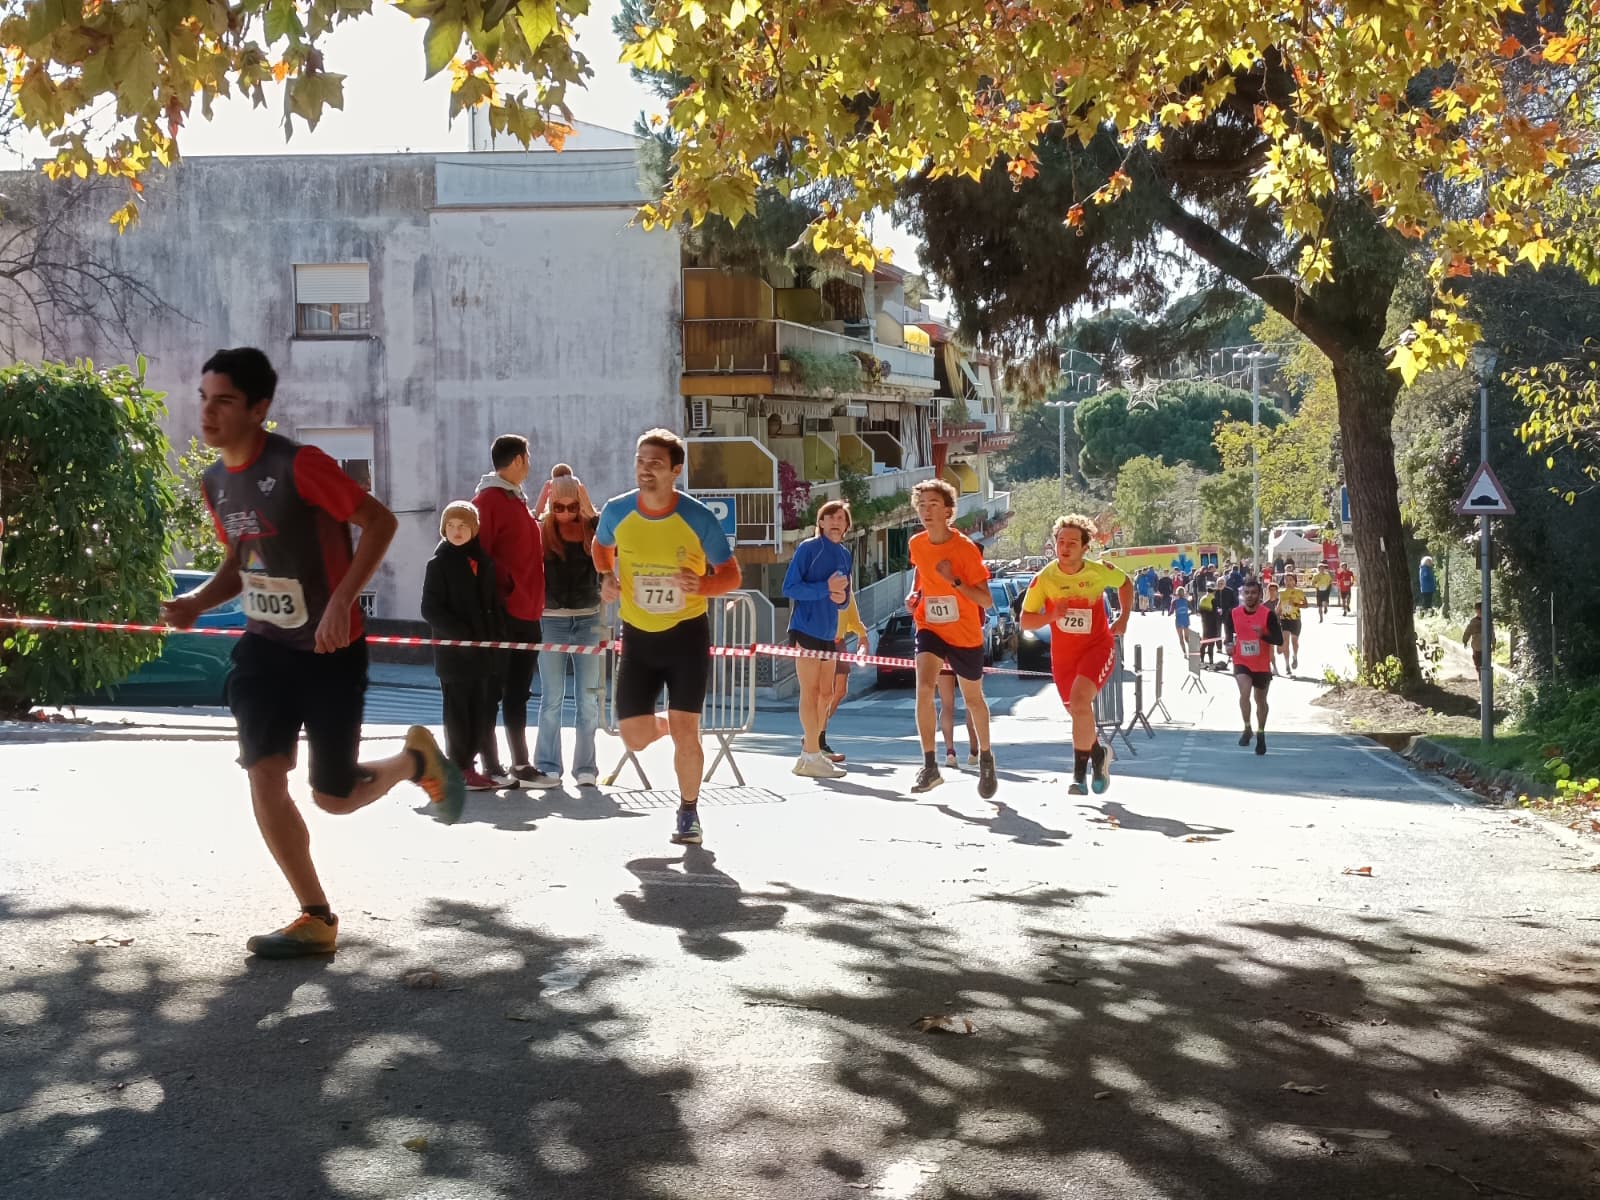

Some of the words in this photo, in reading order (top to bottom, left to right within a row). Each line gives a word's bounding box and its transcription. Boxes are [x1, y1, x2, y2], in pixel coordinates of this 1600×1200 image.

[645, 589, 674, 604] 774
[248, 592, 295, 615] 1003
[930, 605, 949, 616] 401
[1064, 617, 1084, 627] 726
